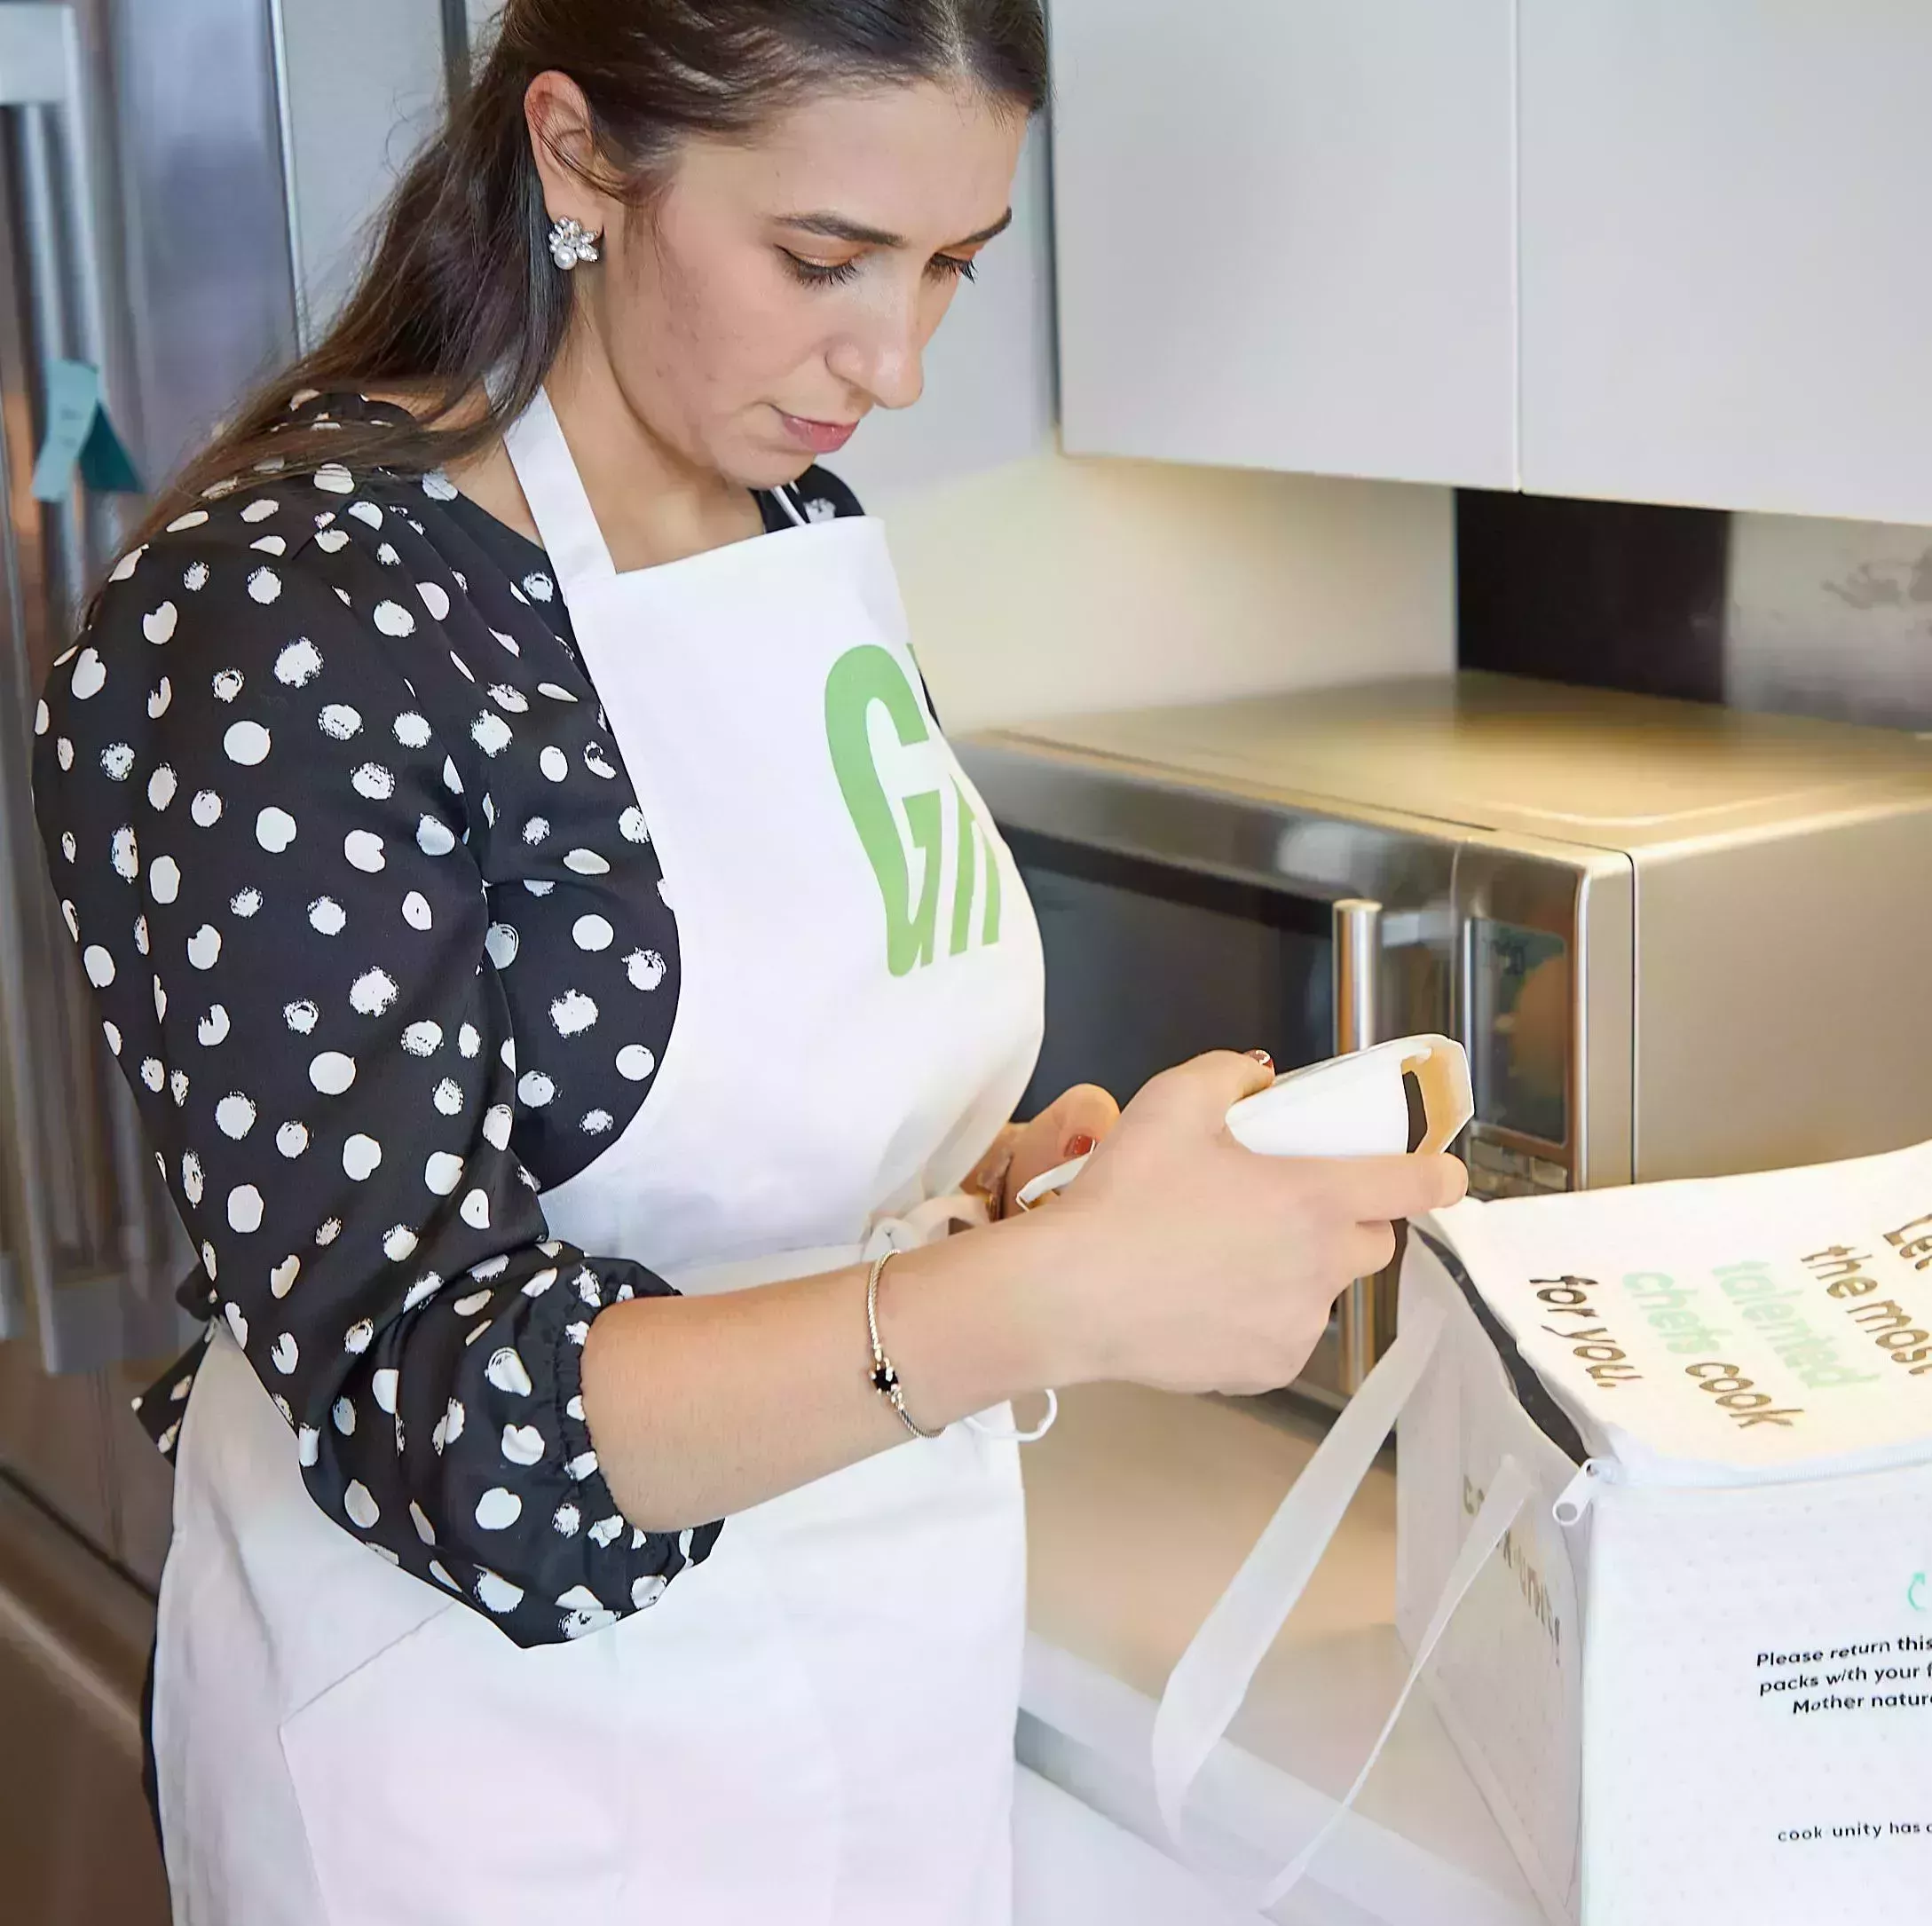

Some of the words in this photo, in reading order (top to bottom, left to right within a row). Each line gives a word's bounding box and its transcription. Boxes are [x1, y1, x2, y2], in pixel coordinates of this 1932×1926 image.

[1801, 1245, 1878, 1298] the
[1528, 1275, 1599, 1317] for
[1711, 1260, 1881, 1389] talented
[1541, 1325, 1643, 1388] you.
[1622, 1272, 1734, 1354] chefs
[1684, 1362, 1804, 1428] cook
[1756, 1652, 1824, 1667] Please
[1830, 1642, 1890, 1659] return
[1760, 1675, 1818, 1696] packs
[1826, 1667, 1867, 1685] with
[1874, 1667, 1920, 1684] your
[1793, 1695, 1864, 1714] Mother
[1872, 1693, 1932, 1706] natur
[1778, 1826, 1822, 1842] cook
[1833, 1821, 1881, 1838] unity
[1889, 1821, 1920, 1834] has
